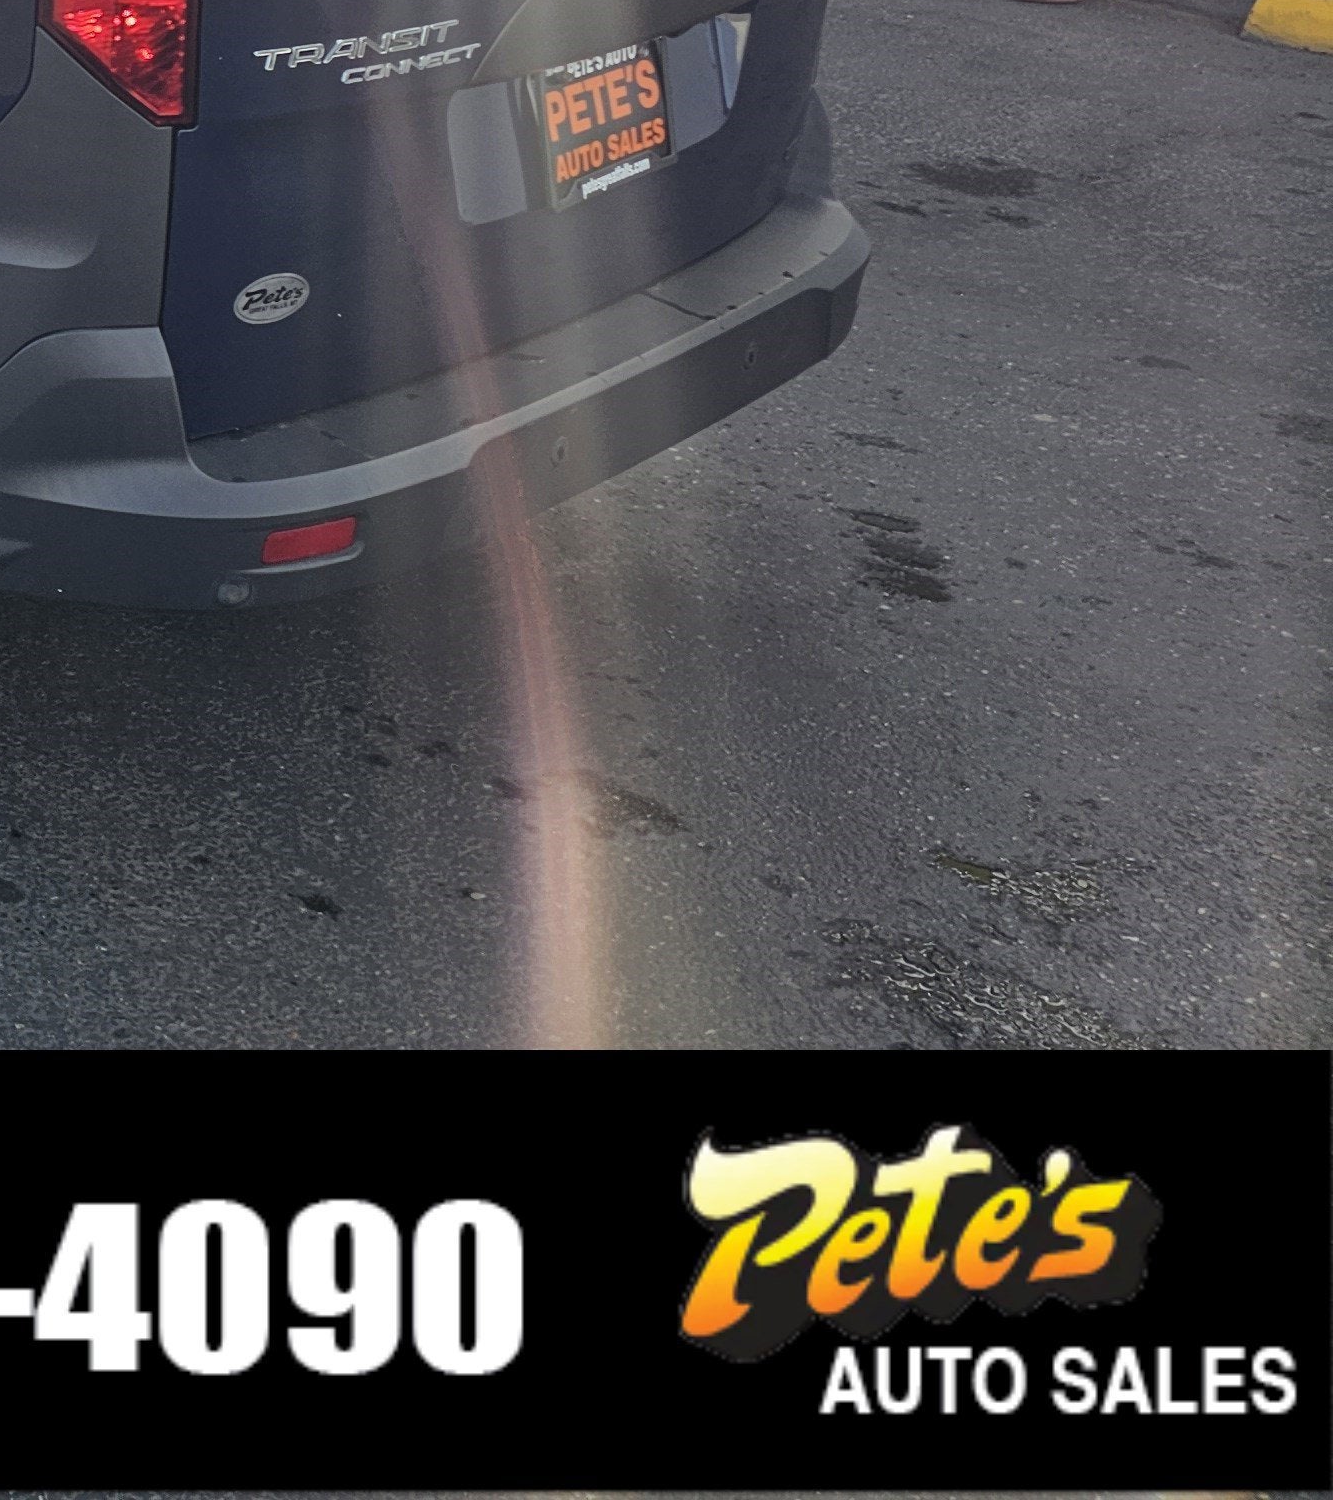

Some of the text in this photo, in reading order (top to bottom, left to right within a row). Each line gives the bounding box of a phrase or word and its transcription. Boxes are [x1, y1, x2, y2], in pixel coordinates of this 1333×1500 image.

[253, 19, 460, 71] TRANSIT
[340, 42, 482, 84] CONNECT
[544, 59, 661, 142] PETE'S
[555, 117, 666, 184] AUTO SALES
[242, 285, 304, 311] Pete's
